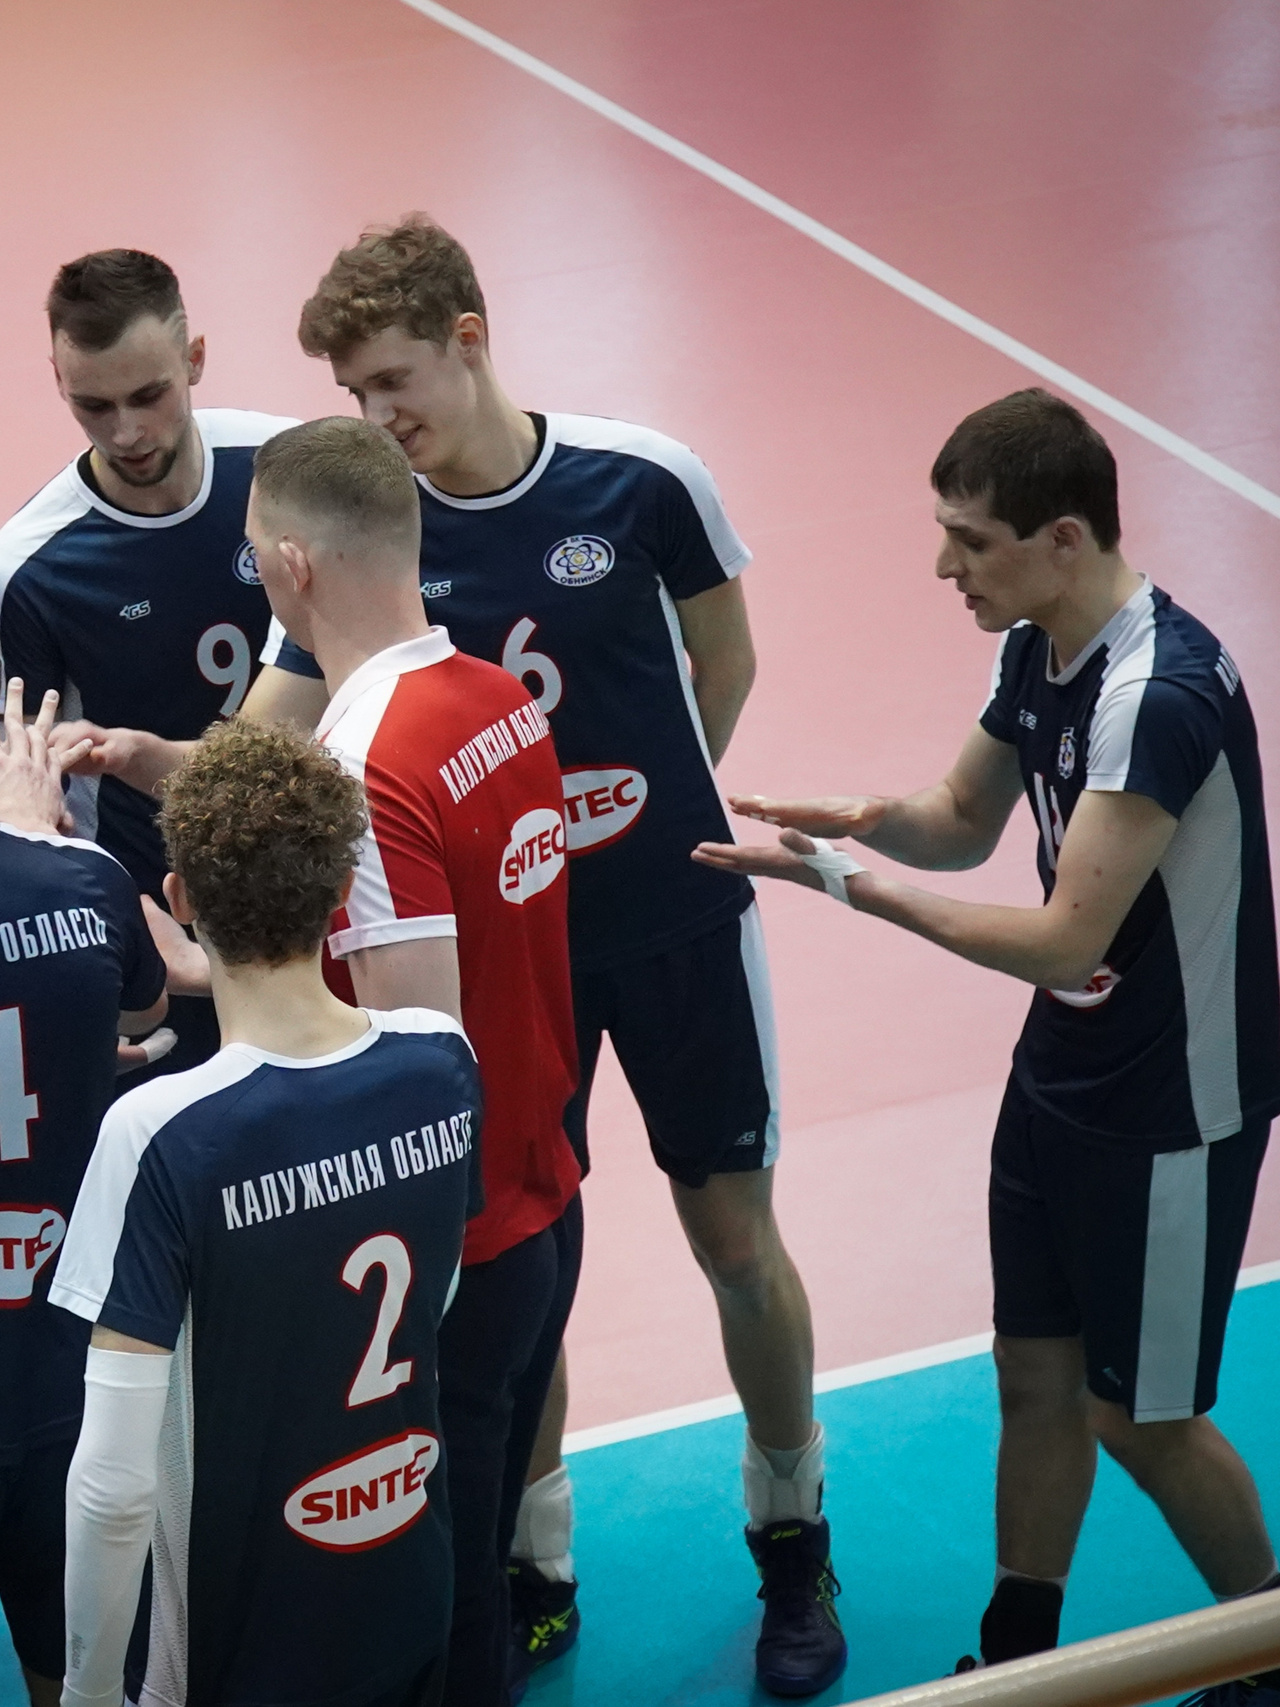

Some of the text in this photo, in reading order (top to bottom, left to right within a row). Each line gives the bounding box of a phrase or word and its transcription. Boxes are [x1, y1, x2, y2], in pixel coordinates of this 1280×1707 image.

[560, 567, 607, 585] ОБНИНСК
[196, 622, 252, 719] 9
[502, 616, 563, 715] 6
[438, 699, 550, 805] КАЛУЖСКАЯ ОБЛА
[563, 776, 639, 825] TEC
[221, 1143, 387, 1230] КАЛУЖСКАЯ
[339, 1231, 415, 1411] 2
